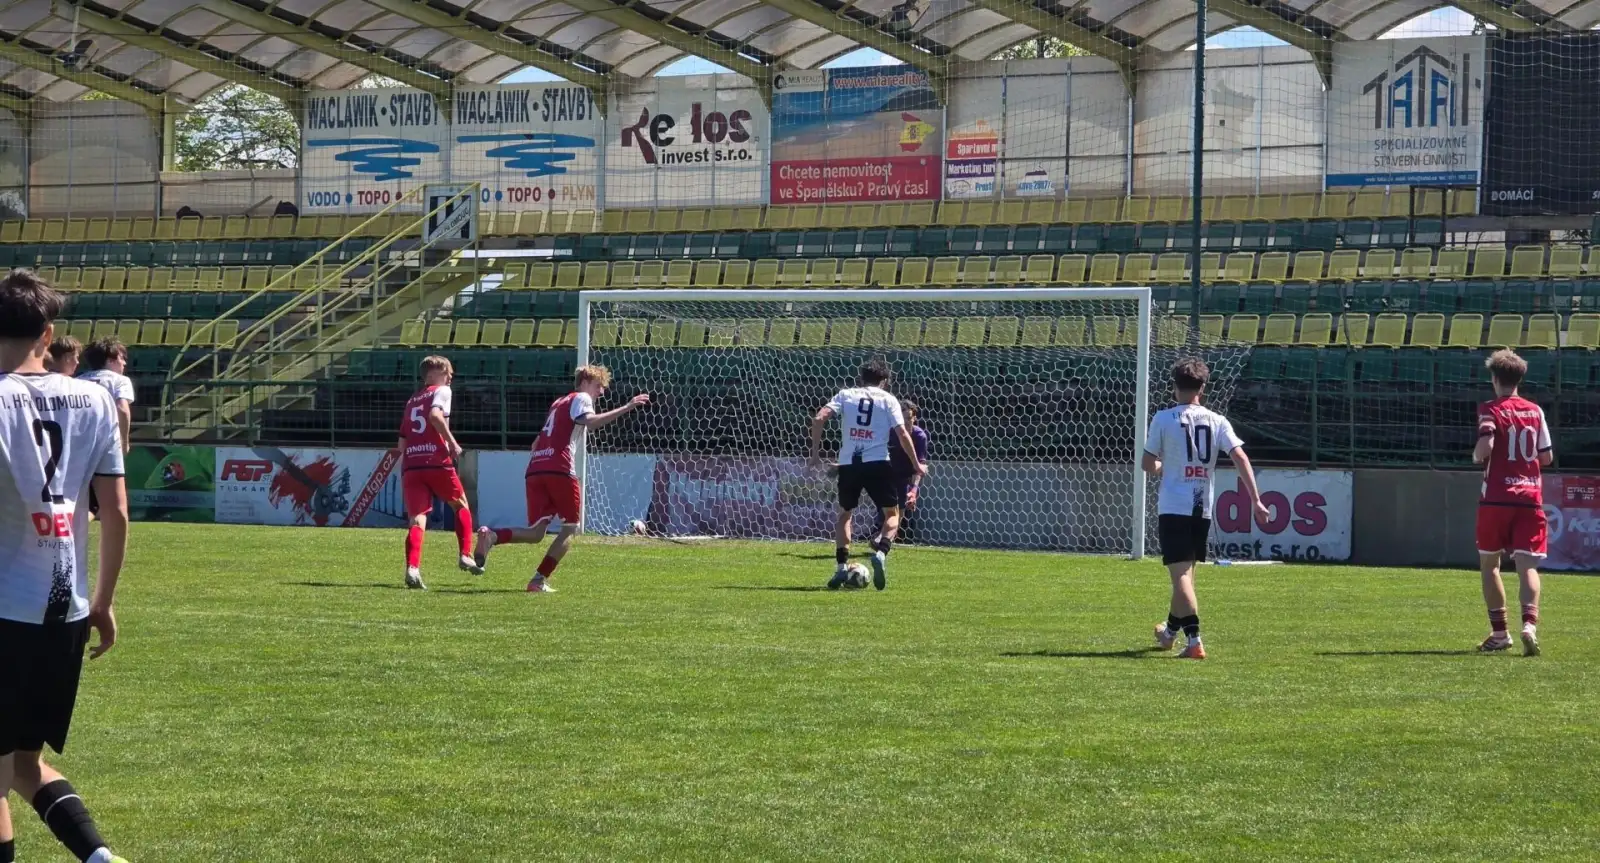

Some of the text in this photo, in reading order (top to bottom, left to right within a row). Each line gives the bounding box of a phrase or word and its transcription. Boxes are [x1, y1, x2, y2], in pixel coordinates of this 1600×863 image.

[833, 71, 930, 89] www.miareality.
[307, 95, 379, 129] WACLAWIK
[457, 87, 595, 125] WACLAWIK STAVBY
[1374, 135, 1467, 151] SPECIALIZOVANÉ
[661, 148, 753, 164] invest s.r.o.
[1374, 153, 1420, 168] STAVEBNÍ
[779, 161, 893, 180] Chcete nemovitost
[307, 191, 341, 207] VODO
[357, 190, 390, 206] TOPO
[507, 187, 542, 203] TOPO
[562, 184, 595, 202] PLYN
[779, 188, 794, 199] ve
[796, 180, 864, 201] Španělsku?
[904, 178, 929, 196] čas!
[1491, 187, 1534, 201] DOMÁCÍ
[35, 394, 91, 412] OLOMOUC
[856, 397, 874, 427] 9
[410, 404, 427, 434] 5
[542, 408, 557, 437] 4
[850, 427, 874, 440] DEK
[1507, 424, 1538, 462] 10
[1180, 423, 1212, 464] 10
[32, 418, 64, 504] 2
[1216, 477, 1328, 536] dos
[1270, 542, 1326, 560] s.r.o.
